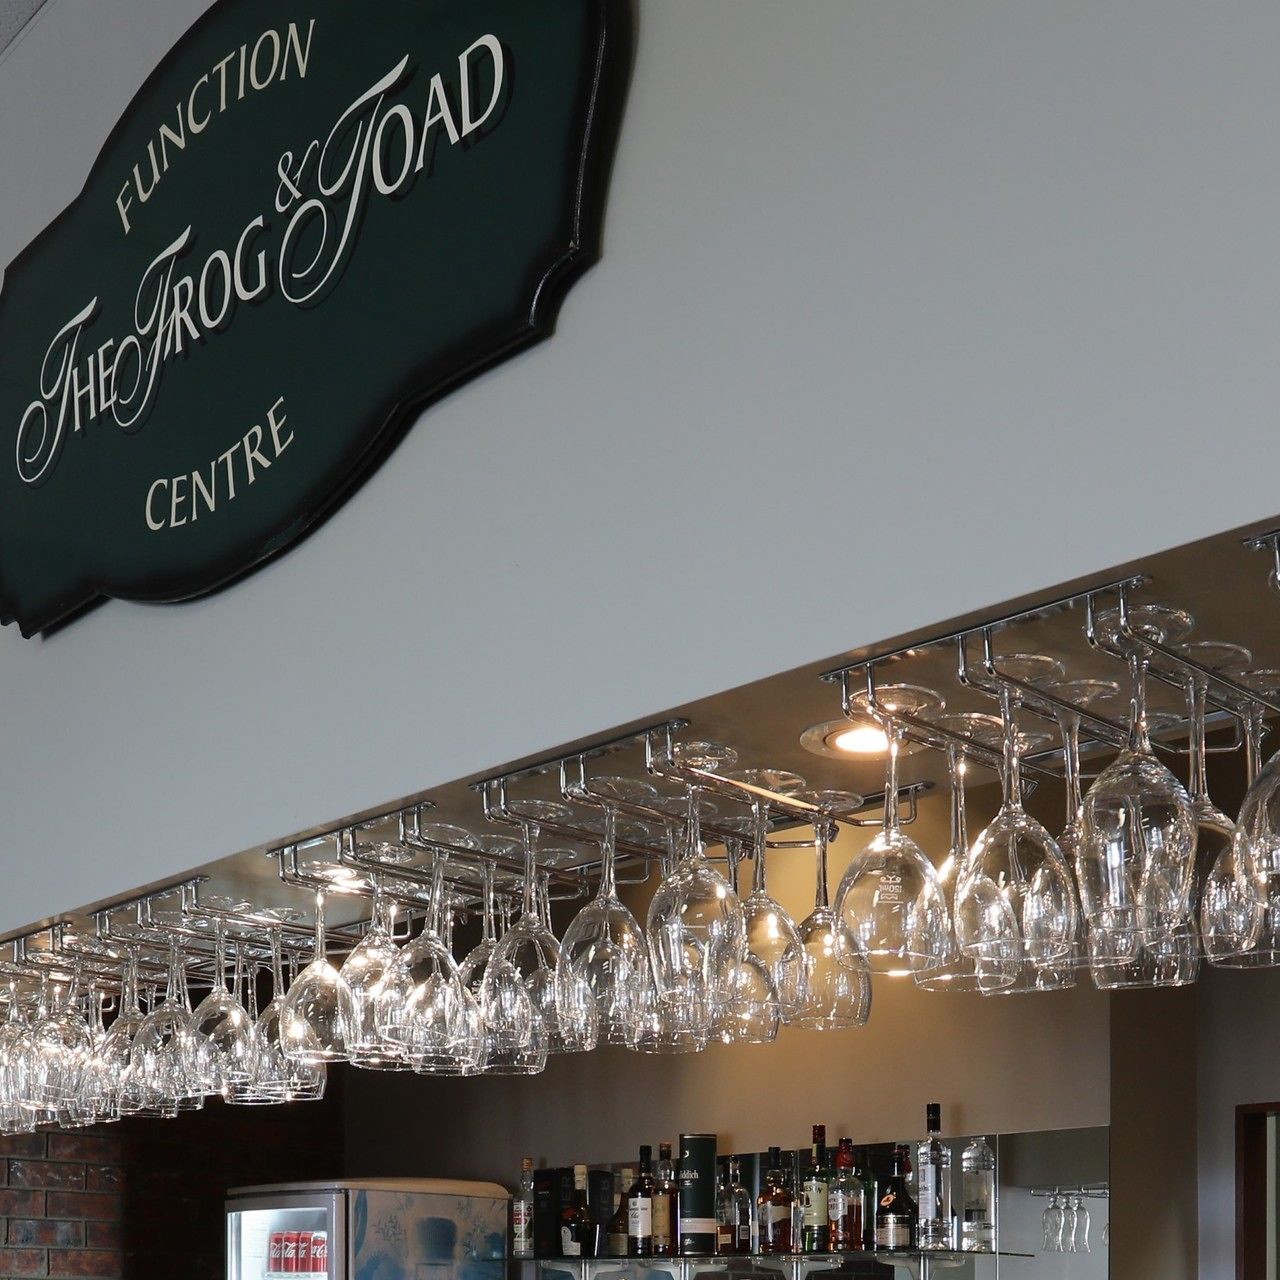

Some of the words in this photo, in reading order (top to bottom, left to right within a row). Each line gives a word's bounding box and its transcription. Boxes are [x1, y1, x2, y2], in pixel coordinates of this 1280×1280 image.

[115, 19, 316, 235] FUNCTION
[274, 139, 319, 214] &
[278, 33, 505, 303] TOAD
[145, 396, 295, 531] CENTRE
